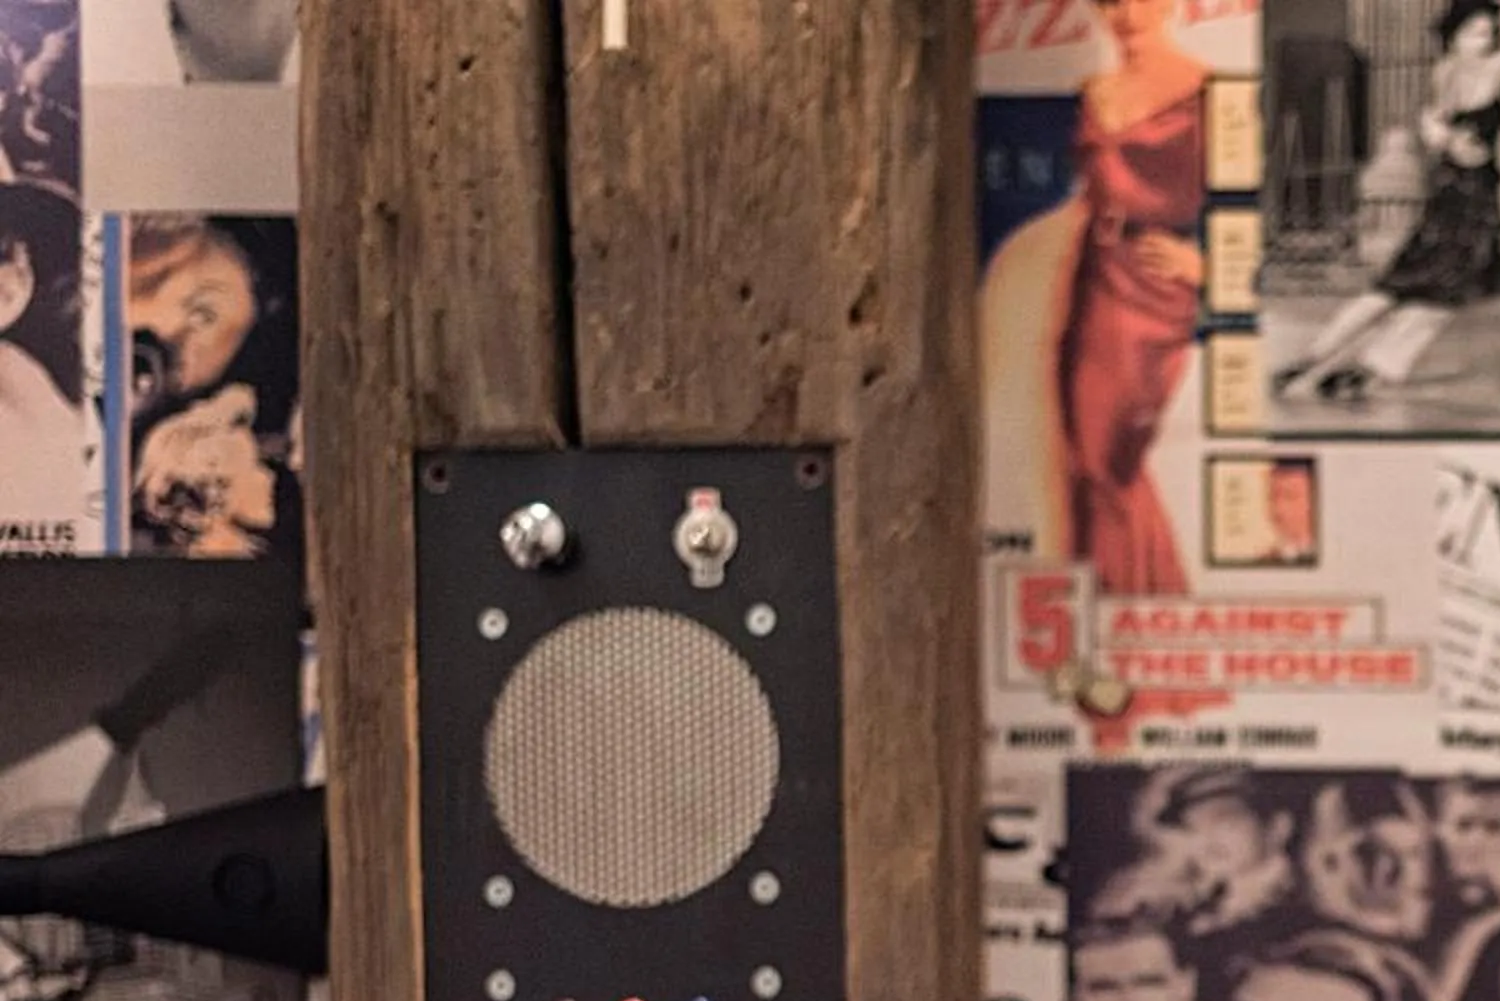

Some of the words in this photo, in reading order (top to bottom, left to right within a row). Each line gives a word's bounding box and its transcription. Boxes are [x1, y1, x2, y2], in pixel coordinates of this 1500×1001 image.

[1019, 573, 1075, 672] 5
[1111, 606, 1348, 635] AGAINST
[1111, 650, 1209, 683] THE
[1222, 650, 1417, 684] HOUSE
